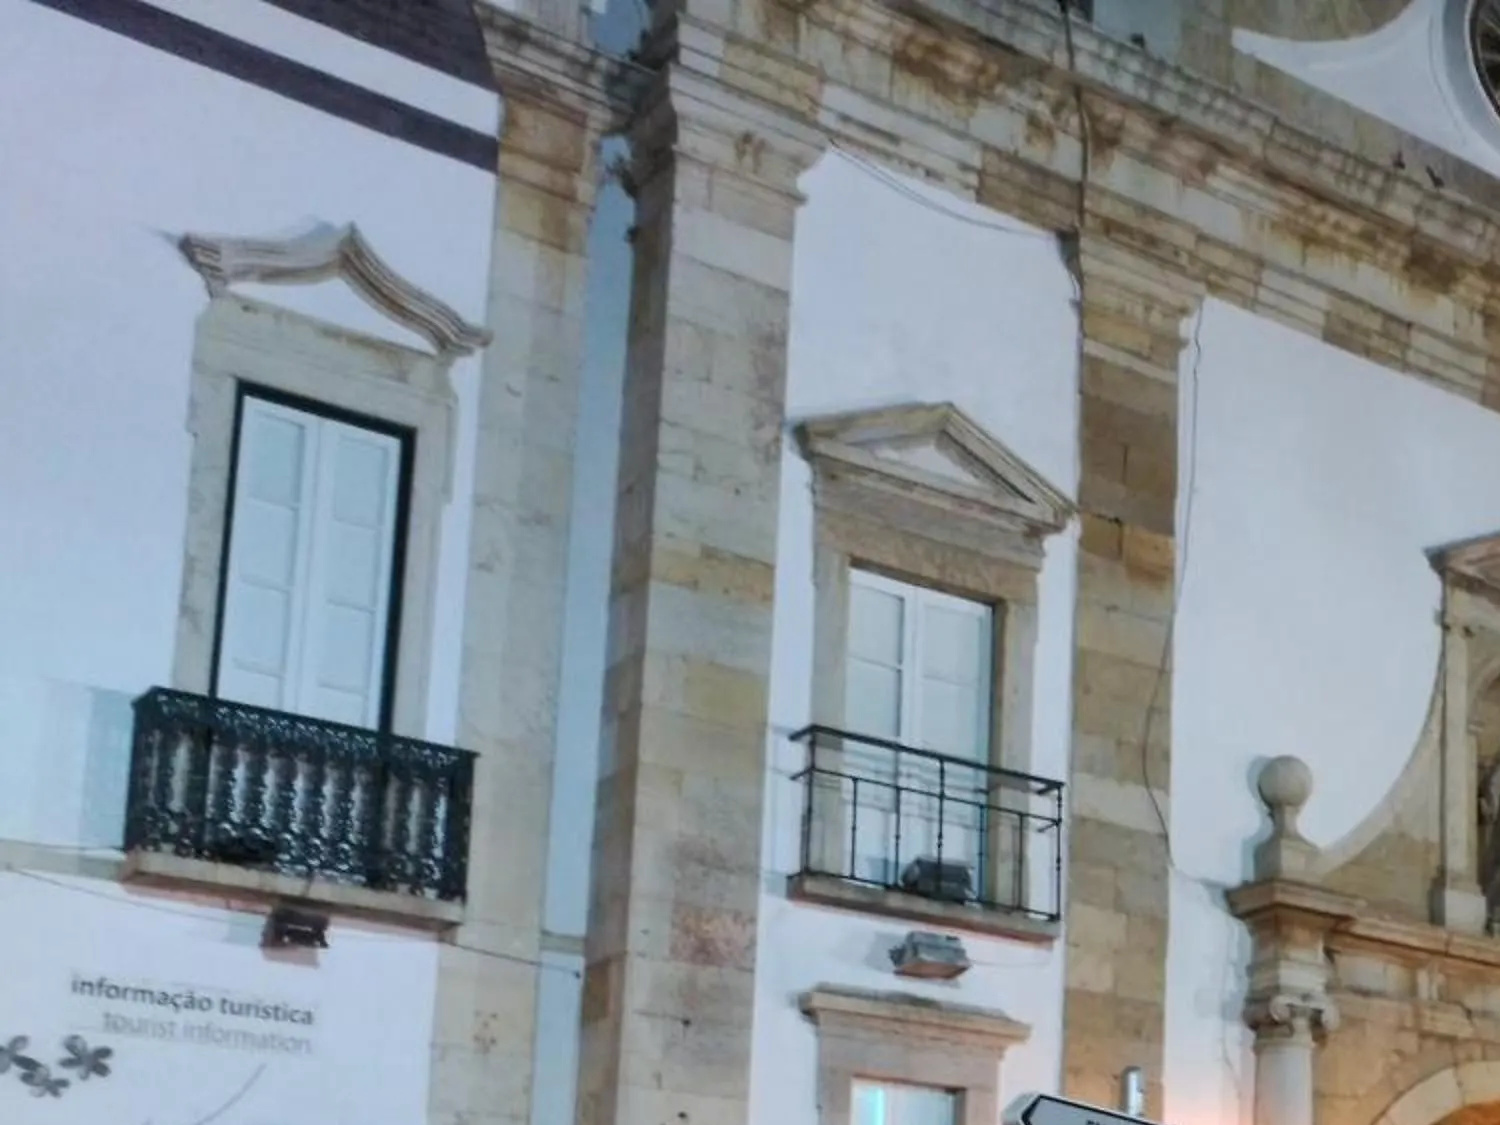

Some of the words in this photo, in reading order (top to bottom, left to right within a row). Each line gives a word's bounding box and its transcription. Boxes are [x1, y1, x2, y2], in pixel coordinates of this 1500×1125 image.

[70, 975, 213, 1014] informação
[102, 1010, 177, 1040] tourist
[182, 1020, 312, 1054] information
